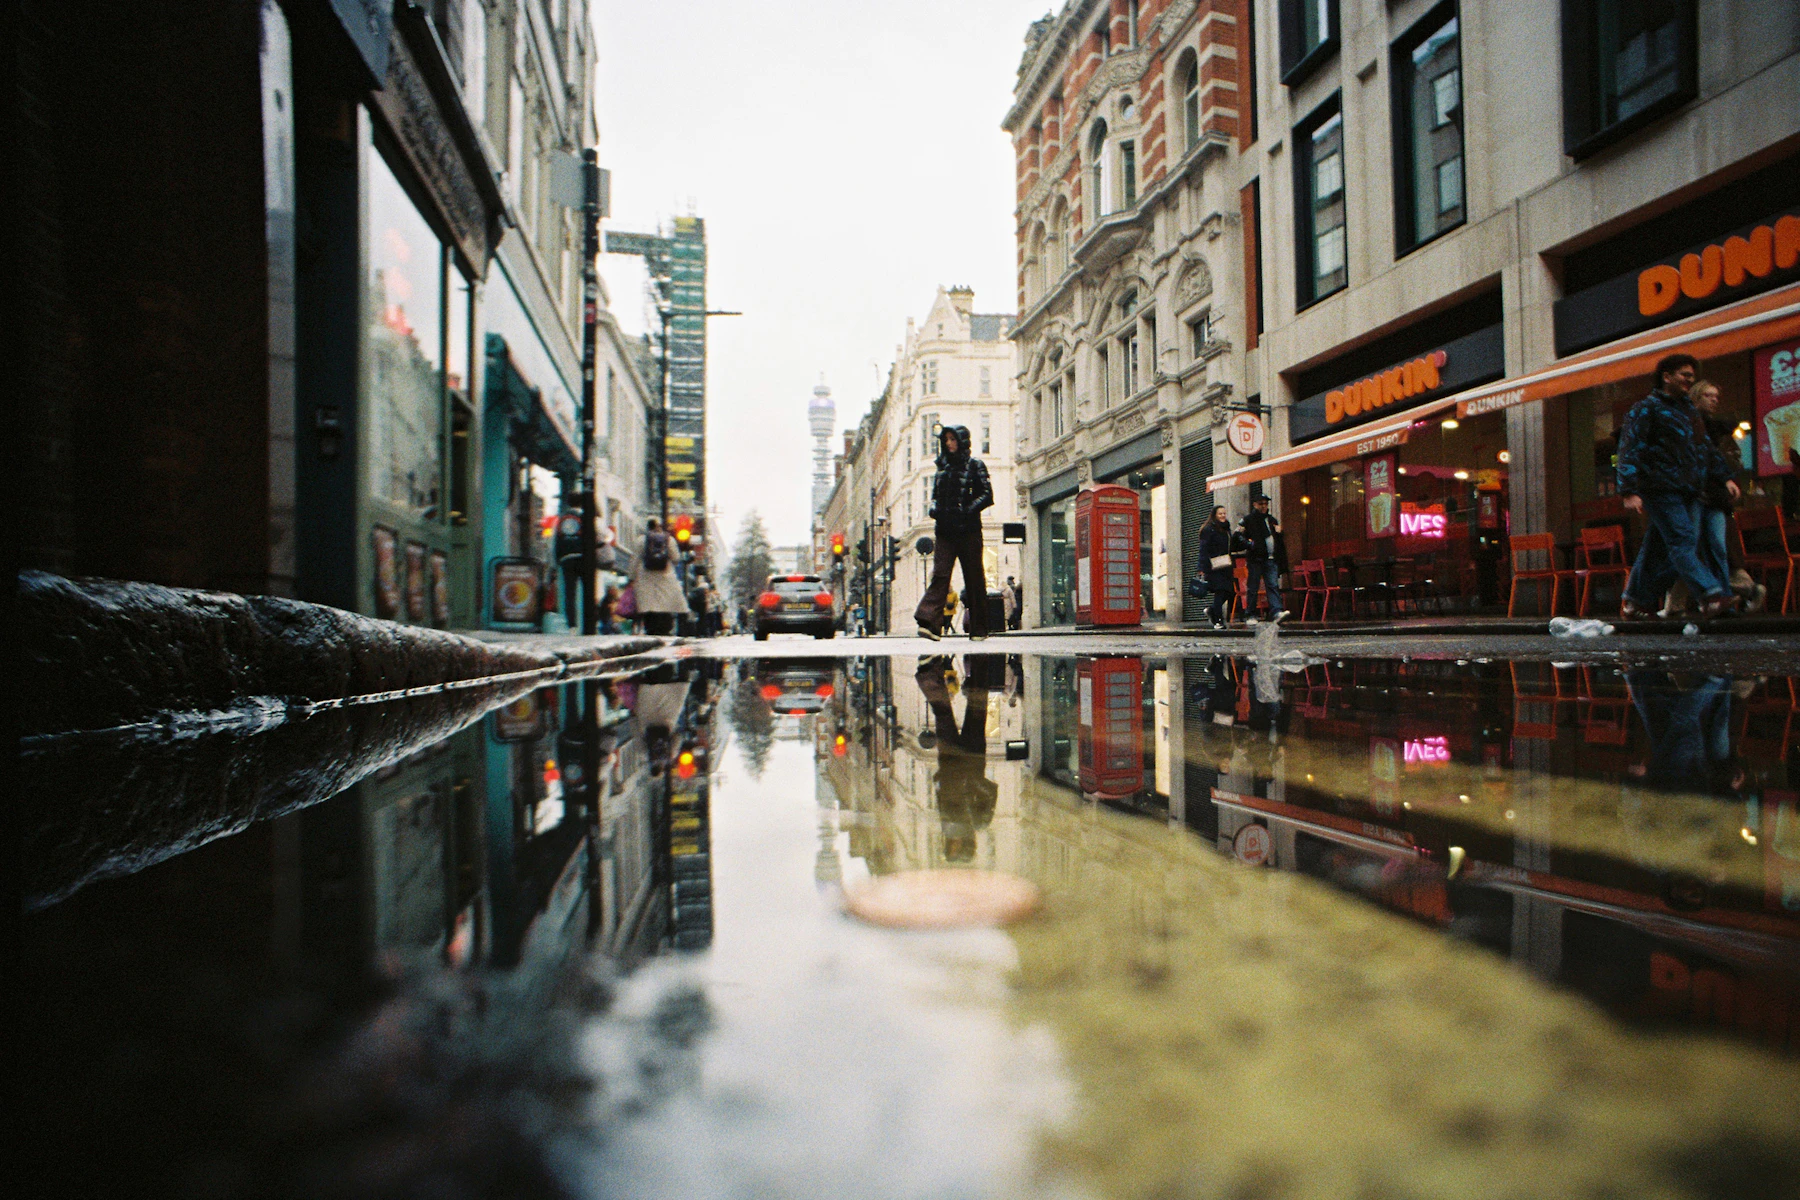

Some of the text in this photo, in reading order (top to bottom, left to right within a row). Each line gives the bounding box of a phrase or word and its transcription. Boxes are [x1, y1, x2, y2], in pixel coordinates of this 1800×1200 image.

[1325, 350, 1447, 424] DUNKIN'
[1466, 389, 1525, 416] DUNKIN'
[1243, 431, 1251, 442] D
[1357, 432, 1399, 455] EST 1950
[1369, 459, 1388, 479] £2
